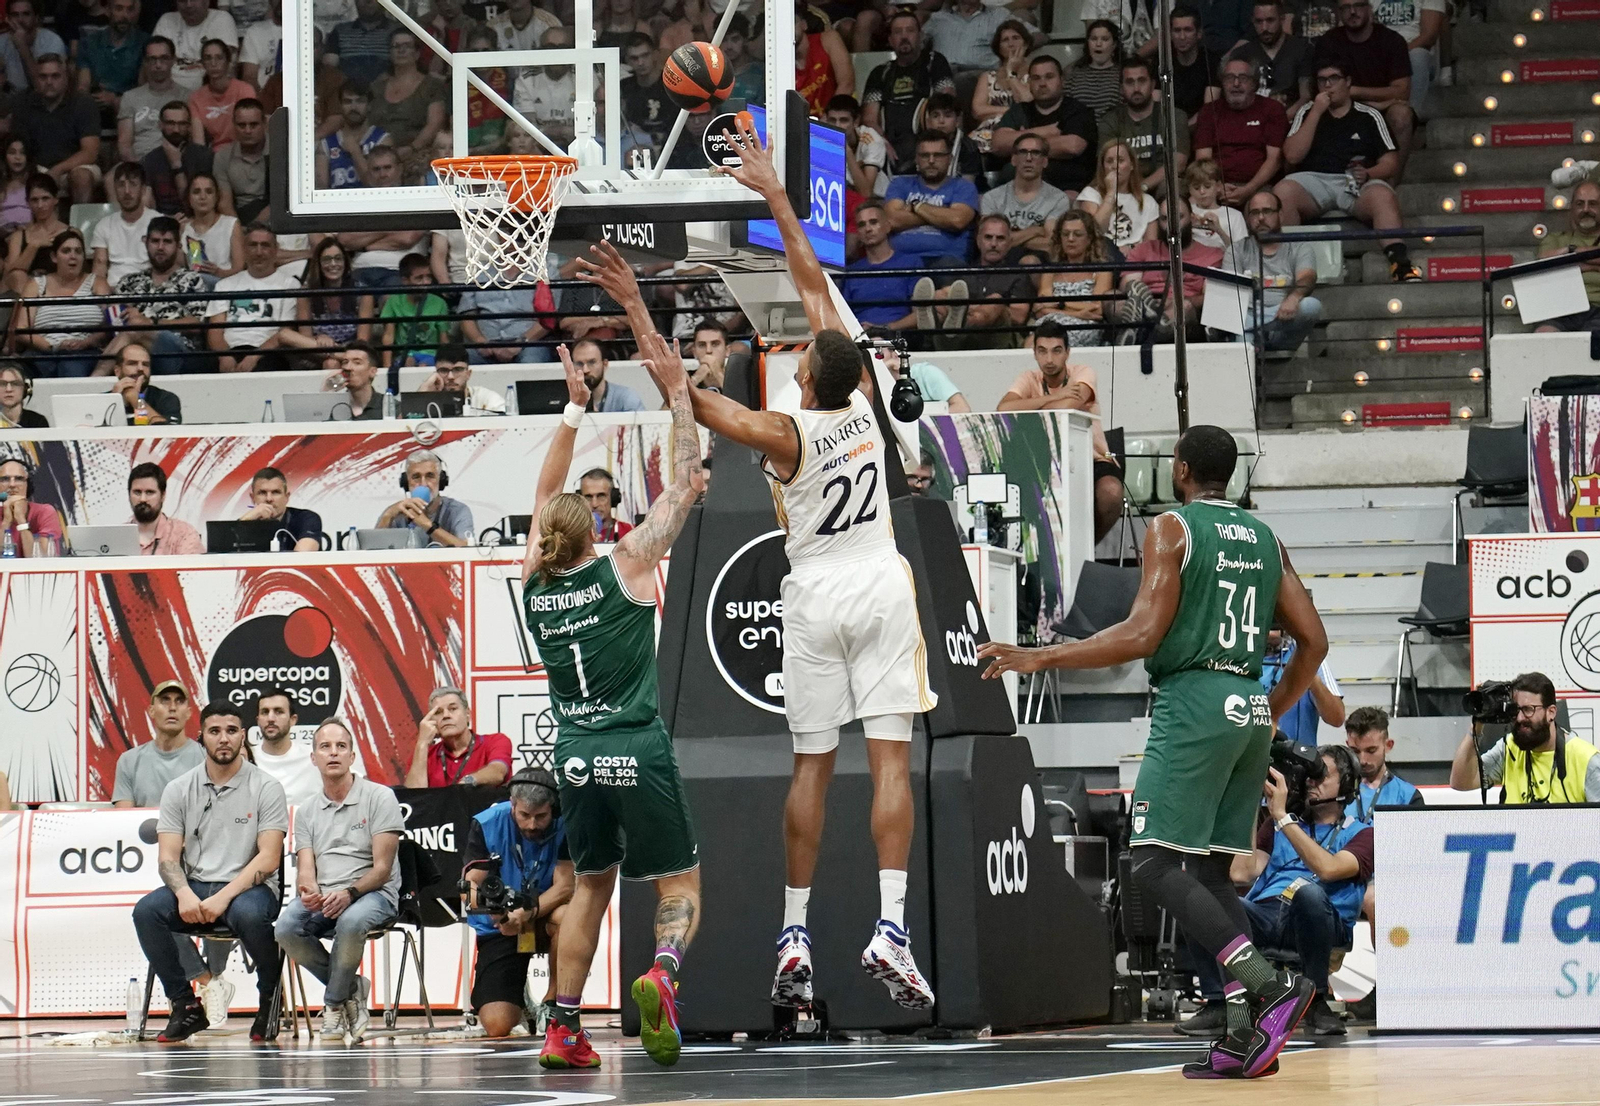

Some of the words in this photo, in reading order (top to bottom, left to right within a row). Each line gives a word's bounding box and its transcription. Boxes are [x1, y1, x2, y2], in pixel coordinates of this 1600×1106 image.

[1459, 335, 1480, 343] Murcia
[811, 413, 872, 456] TAVARES
[821, 441, 874, 473] AUTOHRO
[815, 462, 878, 535] 22
[1214, 522, 1258, 544] THOMAS
[530, 582, 604, 612] OSETKOWSKI
[1496, 568, 1572, 600] acb
[1218, 580, 1260, 652] 34
[945, 624, 979, 667] acb
[218, 666, 330, 685] supercopa
[568, 641, 590, 698] 1
[1252, 707, 1266, 717] DEL
[593, 756, 638, 767] COSTA
[593, 768, 614, 777] DEL
[615, 768, 638, 777] SOL
[594, 776, 638, 787] MÁLAGA
[59, 839, 144, 875] acb
[987, 826, 1029, 896] acb
[1443, 832, 1600, 945] Tra
